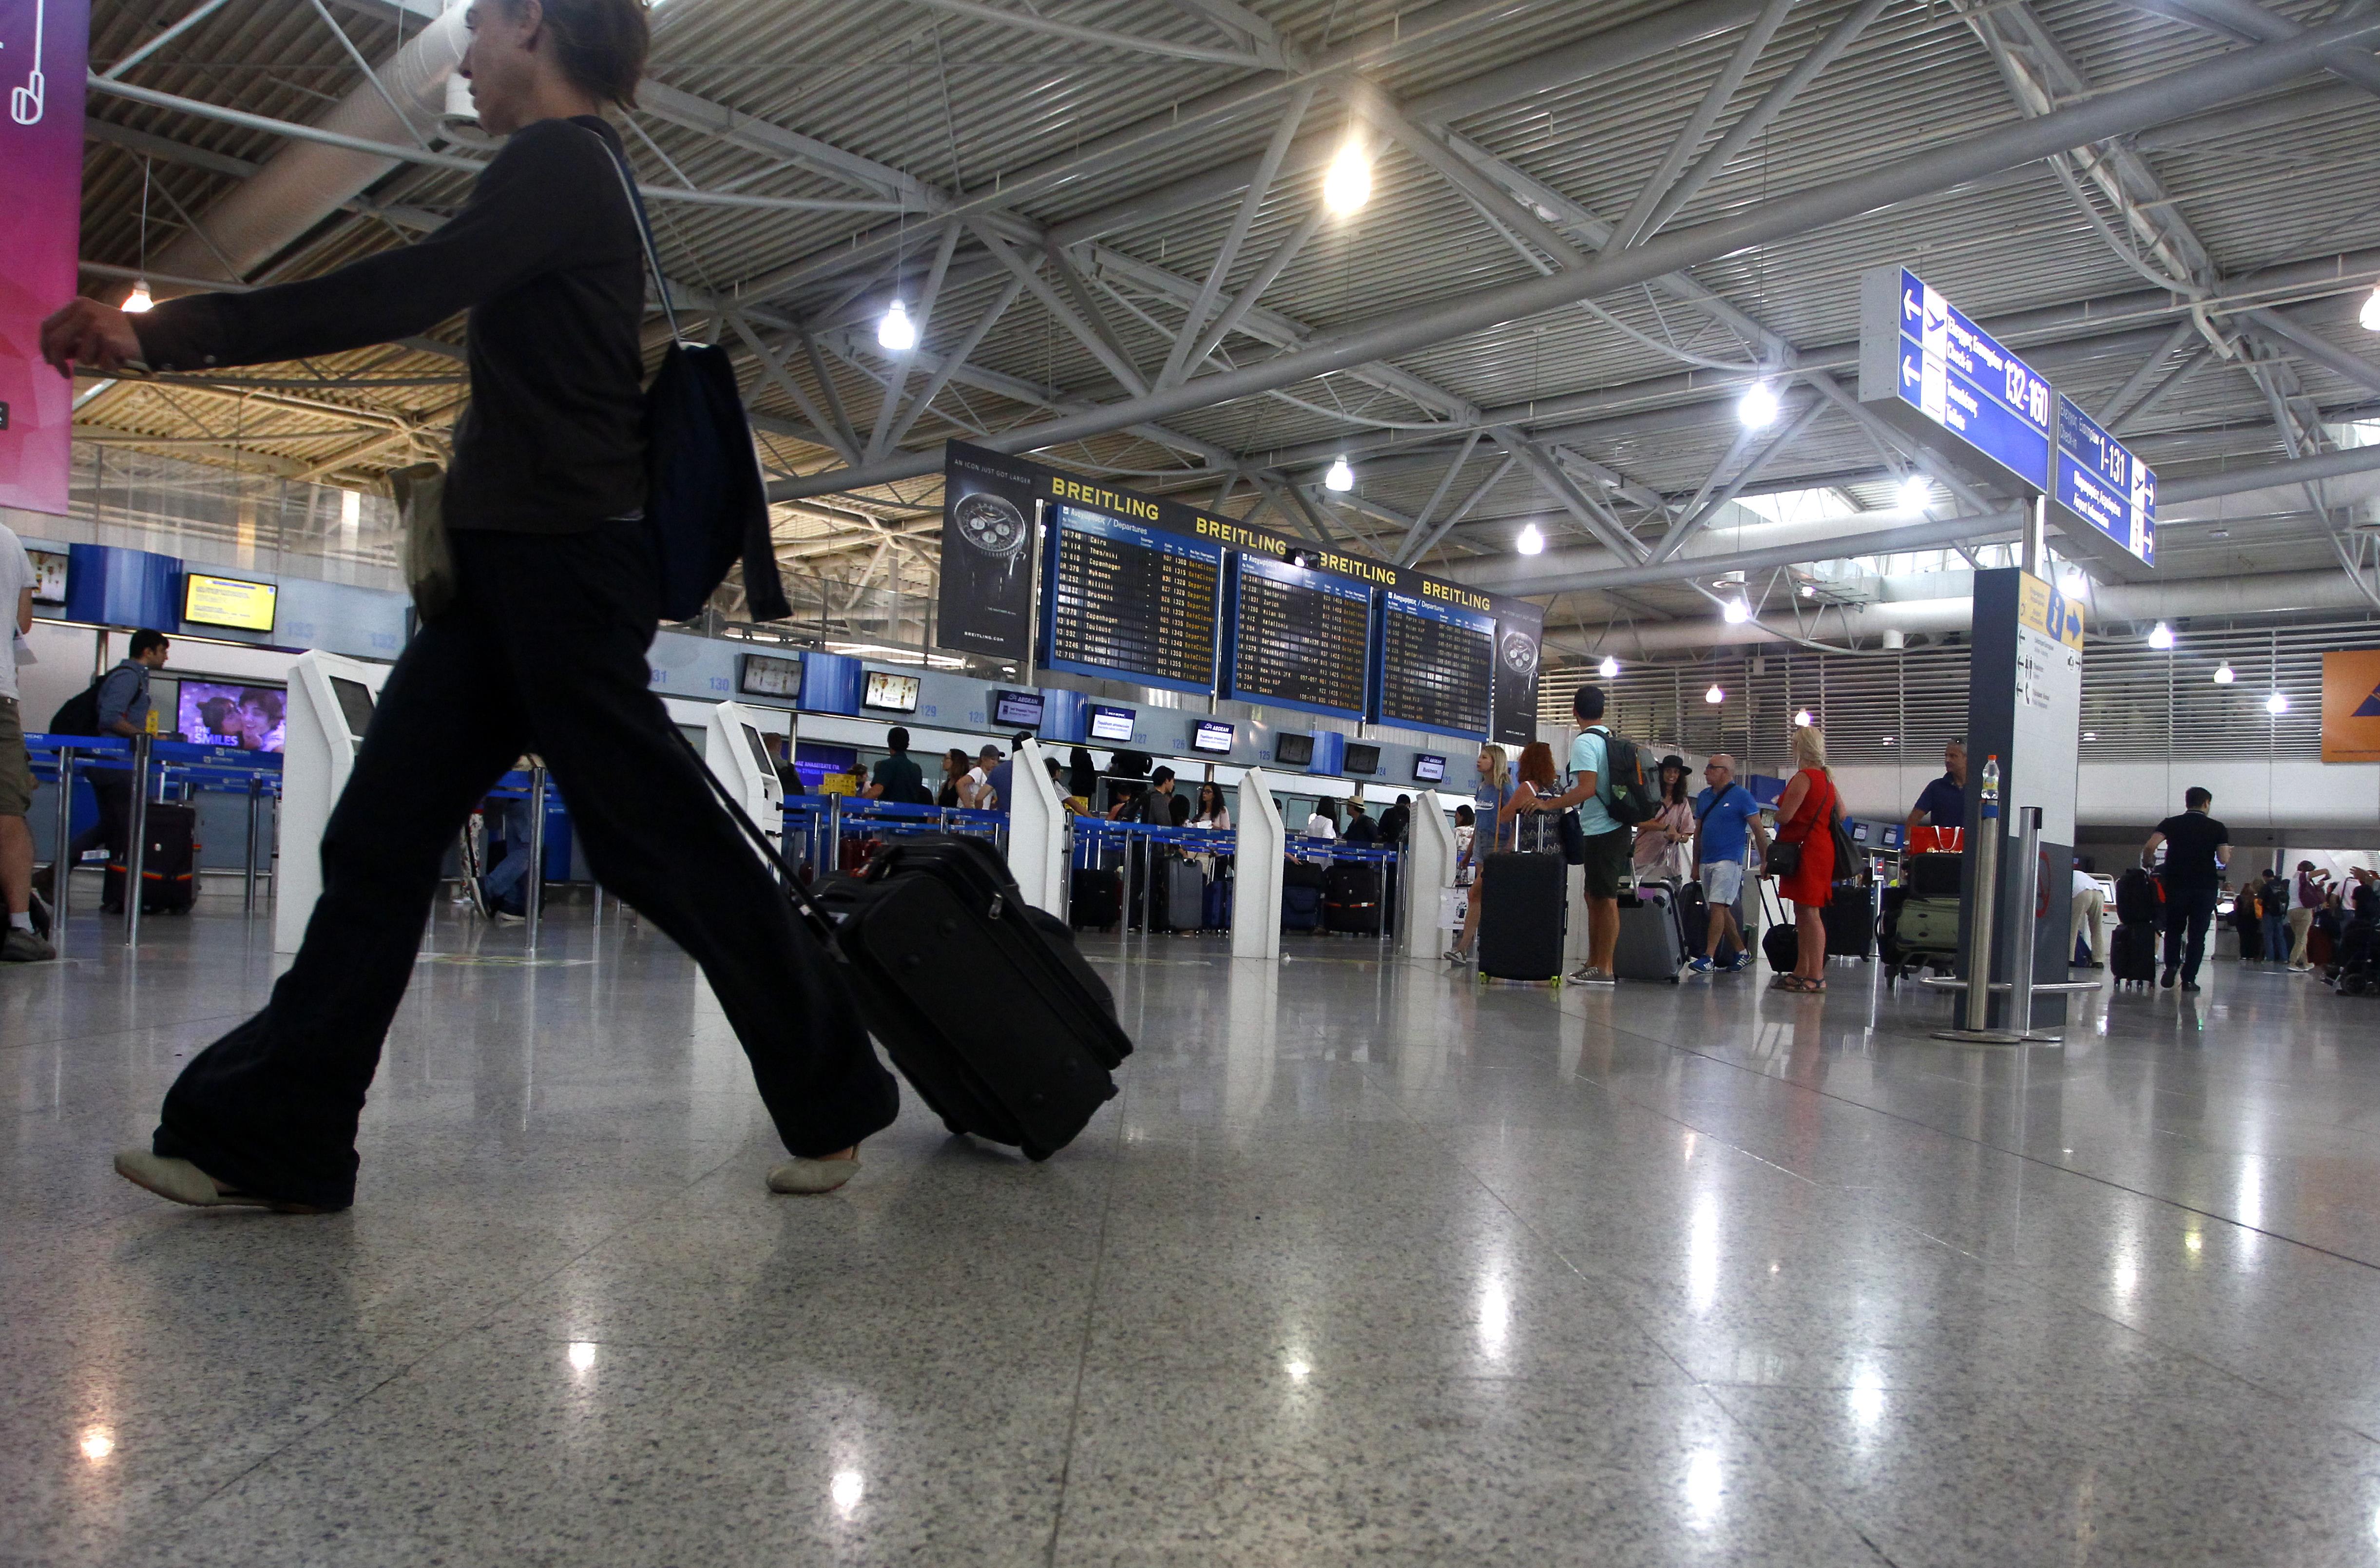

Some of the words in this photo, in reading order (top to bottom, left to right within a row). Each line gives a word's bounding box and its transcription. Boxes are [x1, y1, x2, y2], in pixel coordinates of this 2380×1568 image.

[1947, 341, 1973, 373] Check-in
[2005, 360, 2048, 427] 132-160
[1946, 404, 1965, 431] Toilets
[2060, 424, 2077, 449] Check-in
[2100, 437, 2125, 486] 1-131
[964, 462, 979, 471] ICON
[1010, 474, 1031, 484] LARGER
[1052, 477, 1159, 520] BREITLING
[2073, 492, 2087, 514] Airport
[2088, 502, 2109, 529] Information
[1113, 519, 1148, 535] Departures
[1091, 537, 1106, 546] Cairo
[1196, 517, 1286, 555] BREITLING
[1090, 559, 1120, 571] Copenhagen
[1189, 582, 1210, 591] Departed
[1320, 552, 1396, 585] BREITLING
[1089, 570, 1111, 579] Mykonos
[1188, 592, 1210, 601] Departed
[1088, 591, 1113, 601] Brussels
[1422, 580, 1490, 611] BREITLING
[1187, 602, 1209, 611] Departed
[1421, 600, 1445, 612] Departures
[1086, 623, 1111, 633] Toulouse
[1087, 612, 1118, 623] Copenhagen
[1186, 632, 1208, 641] Departed
[1186, 622, 1209, 631] Departed
[964, 631, 1004, 642] BREITLING.COM
[1086, 634, 1111, 643] Istanbul
[1085, 645, 1110, 654] Brussels
[710, 677, 729, 691] 130
[920, 705, 937, 717] 129
[194, 734, 238, 746] SMILES
[1134, 733, 1147, 744] 127
[1259, 750, 1270, 760] 125
[1377, 767, 1386, 776] 124
[1468, 780, 1477, 788] 122
